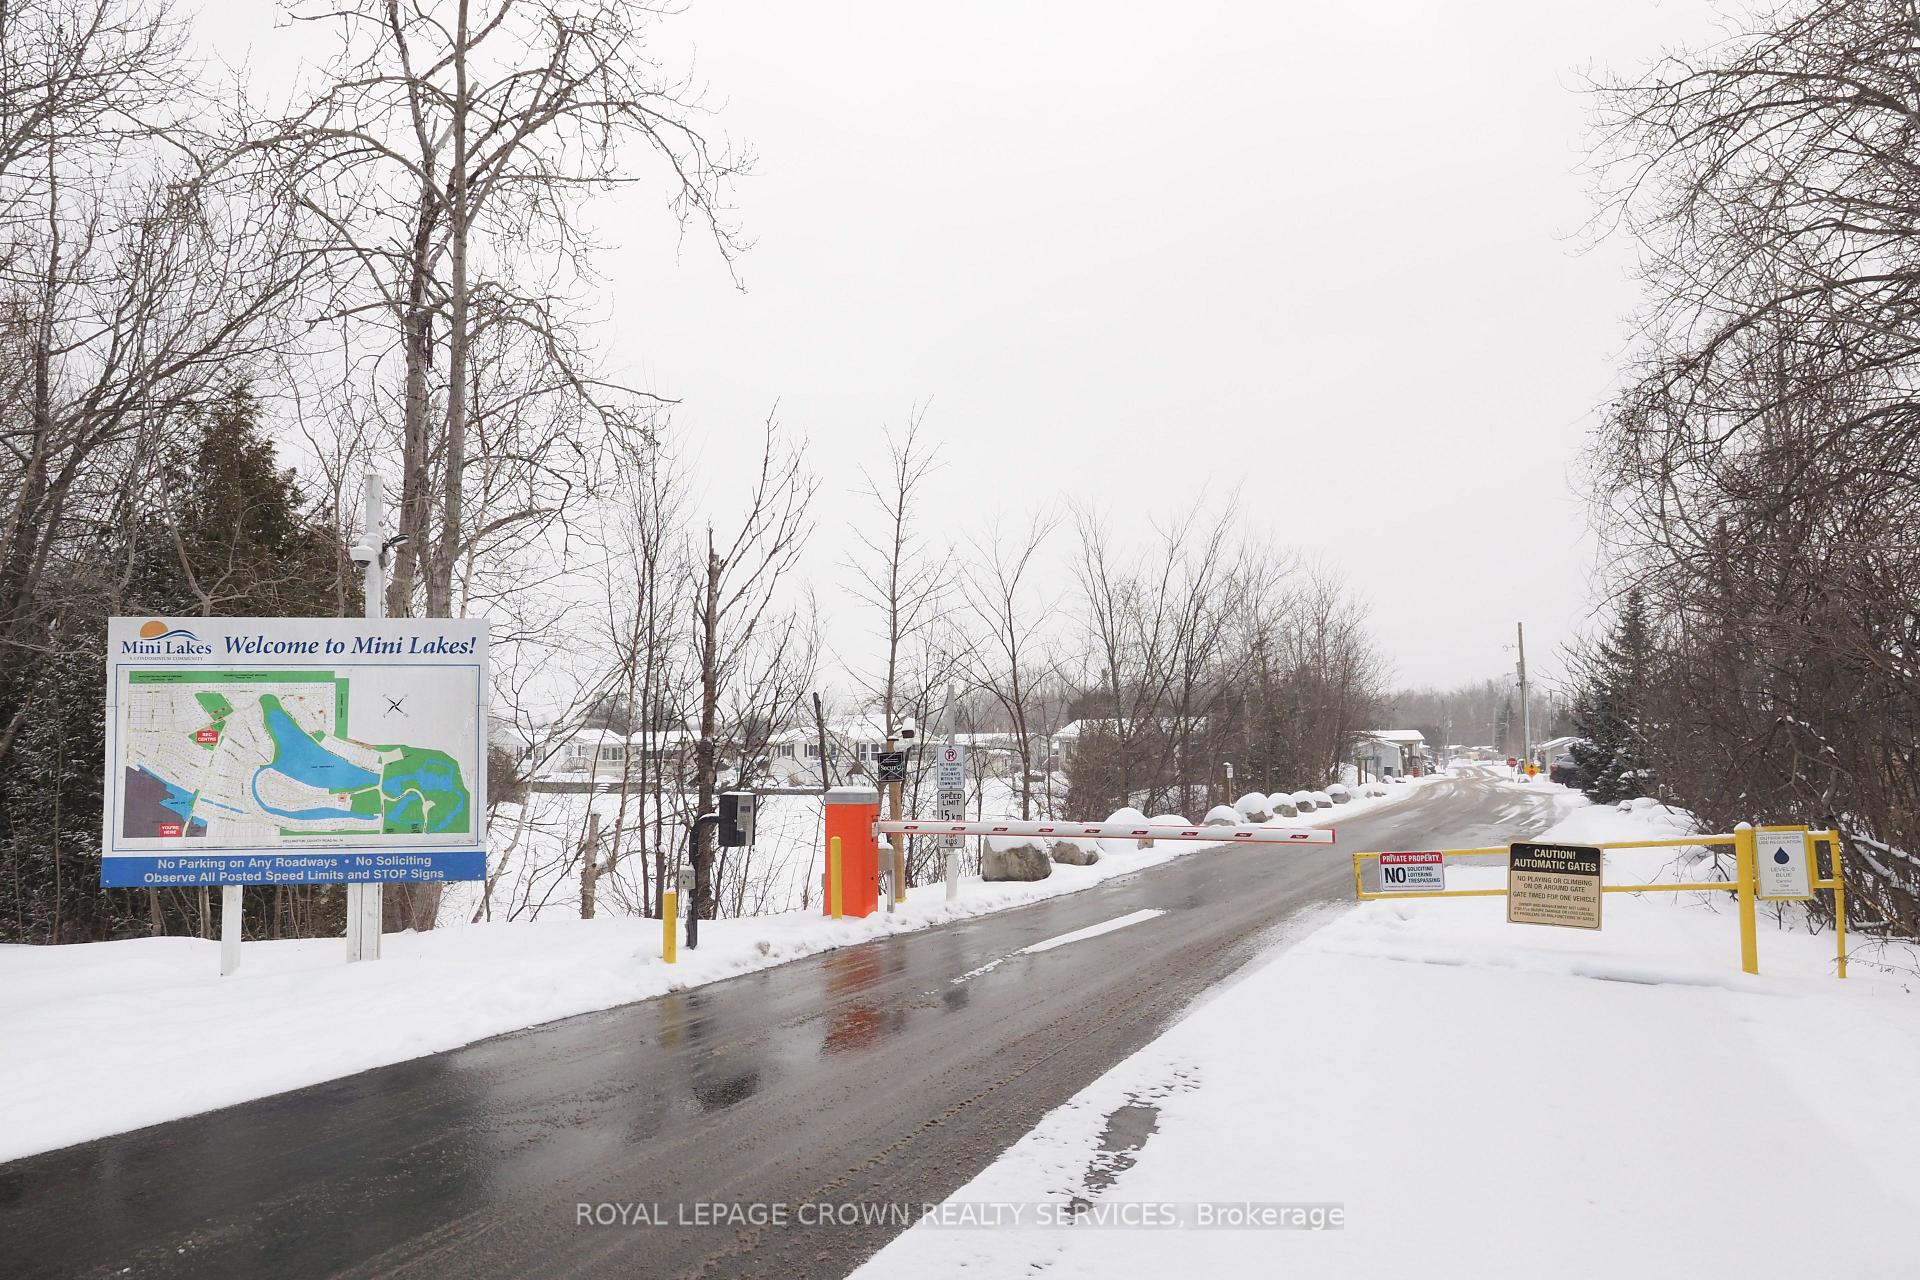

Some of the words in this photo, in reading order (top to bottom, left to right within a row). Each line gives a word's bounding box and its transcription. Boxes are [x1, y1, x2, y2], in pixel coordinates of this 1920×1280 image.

[122, 640, 161, 654] Mini
[166, 640, 212, 655] Lakes
[225, 635, 319, 654] Welcome
[325, 638, 345, 654] to
[351, 636, 403, 654] Mini
[408, 636, 477, 654] Lakes!
[1408, 854, 1440, 862] PROPERTY
[1534, 849, 1576, 860] CAUTION!
[157, 859, 175, 869] No
[179, 858, 225, 870] Parking
[229, 860, 244, 868] on
[248, 858, 272, 869] Any
[276, 857, 337, 869] Roadways
[355, 856, 372, 866] No
[376, 856, 432, 867] Soliciting
[1514, 859, 1565, 870] AUTOMATIC
[1567, 861, 1597, 872] GATES
[144, 873, 195, 883] Observe
[199, 872, 215, 882] All
[220, 871, 262, 882] Posted
[265, 871, 304, 883] Speed
[308, 871, 344, 880] Limits
[348, 870, 369, 879] and
[374, 870, 407, 879] STOP
[411, 869, 444, 880] Signs
[1384, 867, 1407, 883] NO
[1528, 876, 1552, 884] PLAYING
[1563, 878, 1593, 887] CLIMBING
[1543, 884, 1569, 892] AROUND
[1573, 895, 1597, 903] VEHICLE
